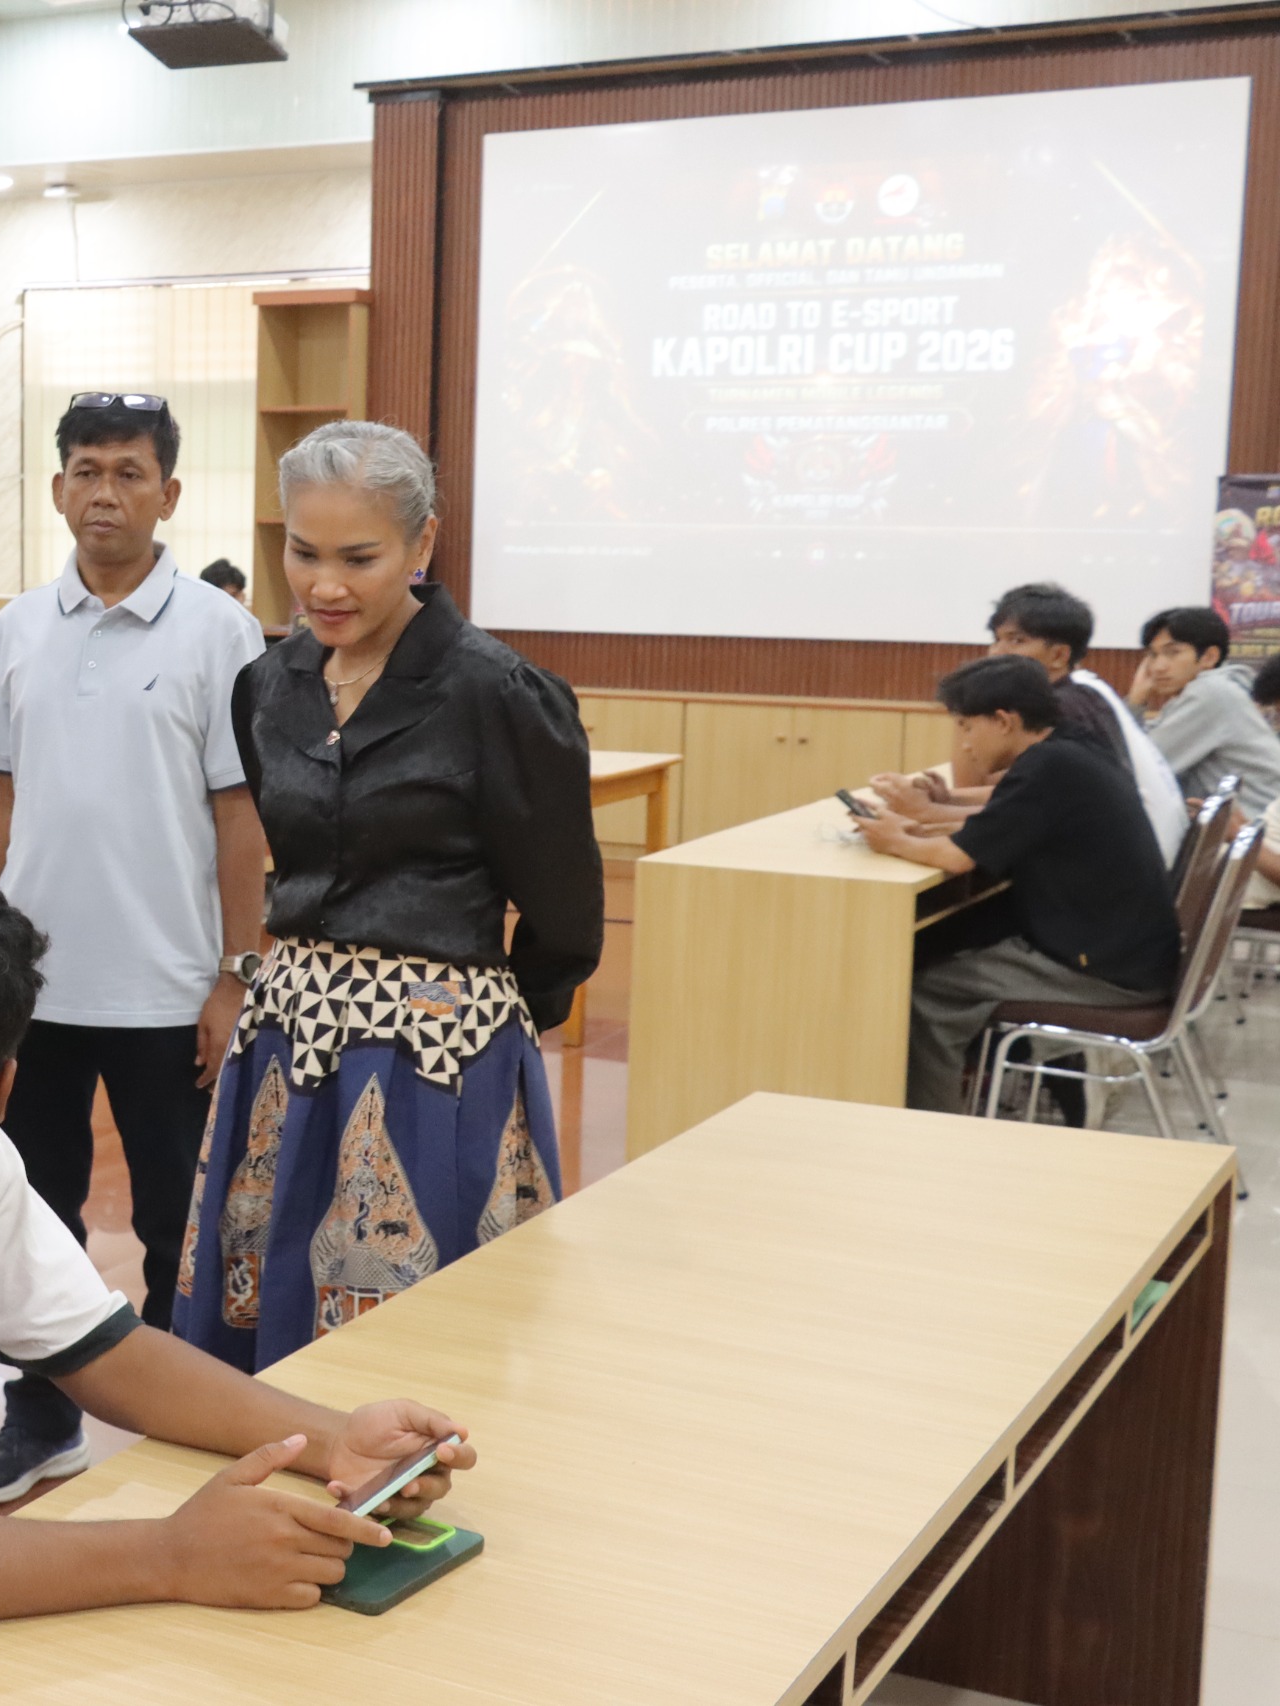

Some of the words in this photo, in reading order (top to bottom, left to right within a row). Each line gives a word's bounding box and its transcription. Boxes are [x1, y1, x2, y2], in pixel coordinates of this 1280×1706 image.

[704, 238, 835, 270] SELAMAT
[845, 232, 966, 265] DATANG
[702, 301, 776, 332] ROAD
[785, 300, 821, 329] TO
[829, 296, 959, 328] E-SPORT
[651, 333, 817, 378] KAPOLRI
[827, 331, 908, 374] CUP
[916, 327, 1016, 373] 2026
